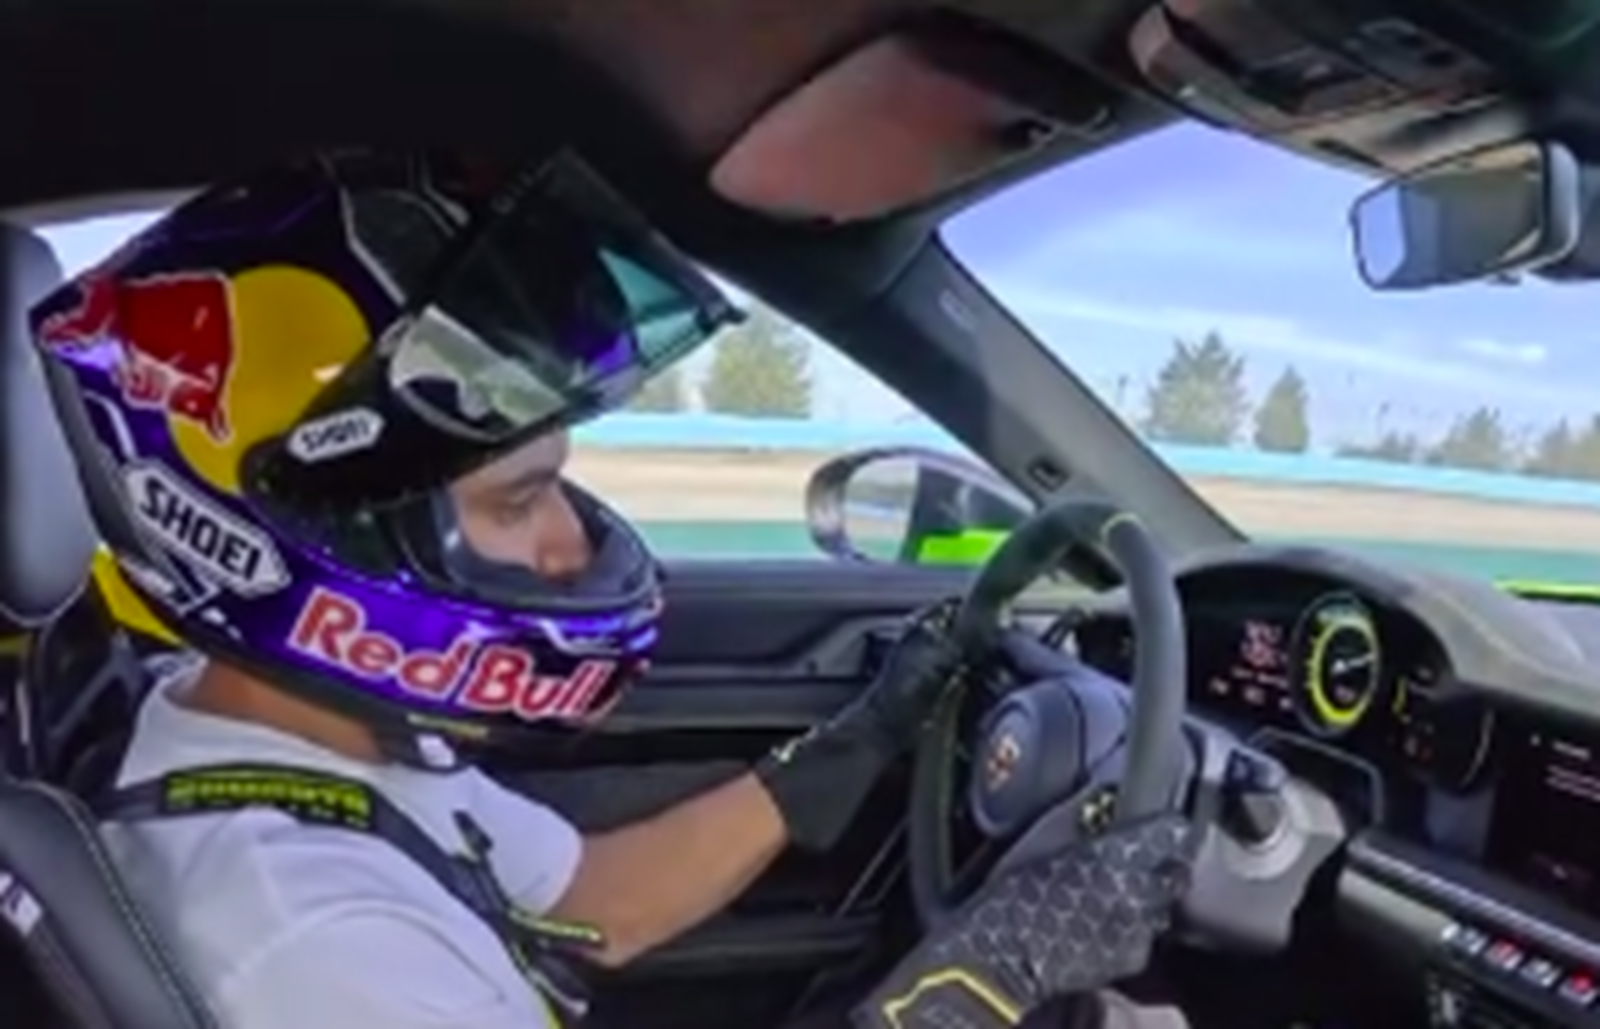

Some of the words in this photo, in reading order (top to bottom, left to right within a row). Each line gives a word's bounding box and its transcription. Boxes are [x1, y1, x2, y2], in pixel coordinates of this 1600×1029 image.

[139, 475, 262, 582] SHOEI
[287, 586, 479, 699] Red
[456, 645, 614, 720] Bull
